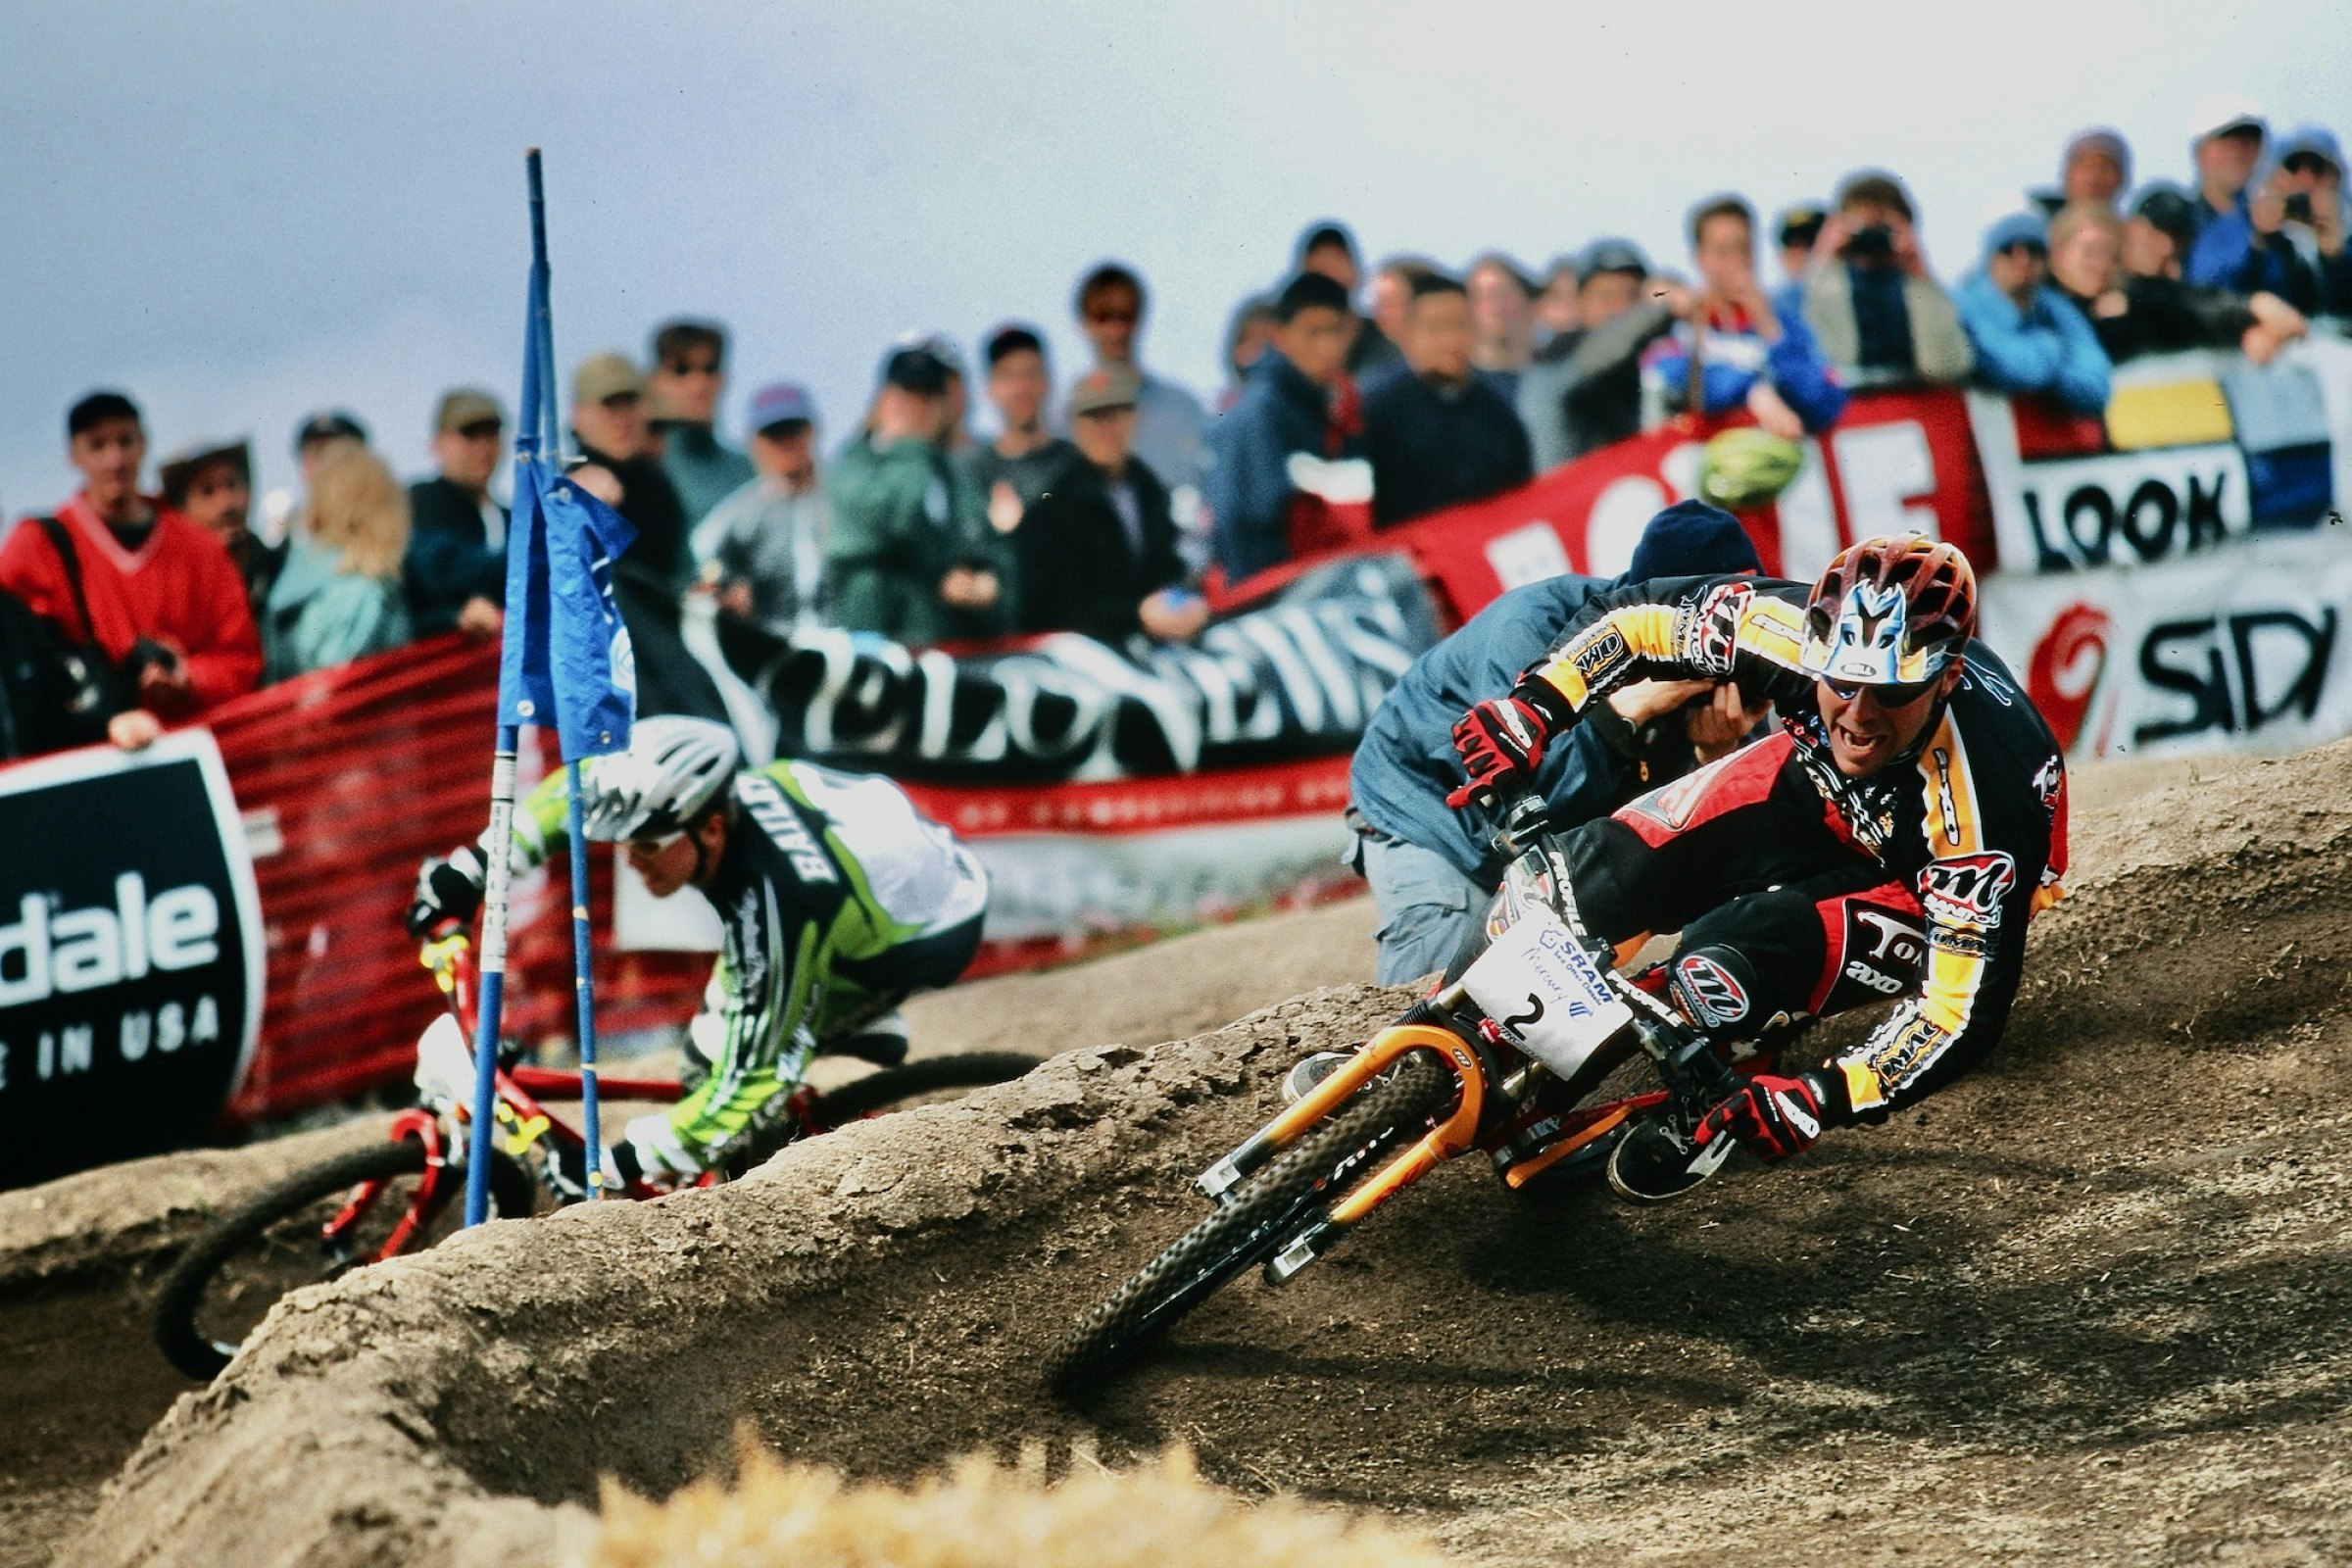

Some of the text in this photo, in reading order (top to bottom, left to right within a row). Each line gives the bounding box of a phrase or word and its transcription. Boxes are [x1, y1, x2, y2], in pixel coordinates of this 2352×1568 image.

[2024, 470, 2226, 573] LOOK
[2134, 606, 2334, 747] SIDI
[1547, 851, 1588, 937] PROFILE
[0, 869, 220, 1008] dale
[1559, 941, 1615, 1004] SRAM
[1845, 960, 1904, 994] axo
[36, 1023, 95, 1081] IN
[119, 994, 220, 1061] USA
[1502, 992, 1545, 1042] 2
[1605, 968, 1685, 1029] PROFILE
